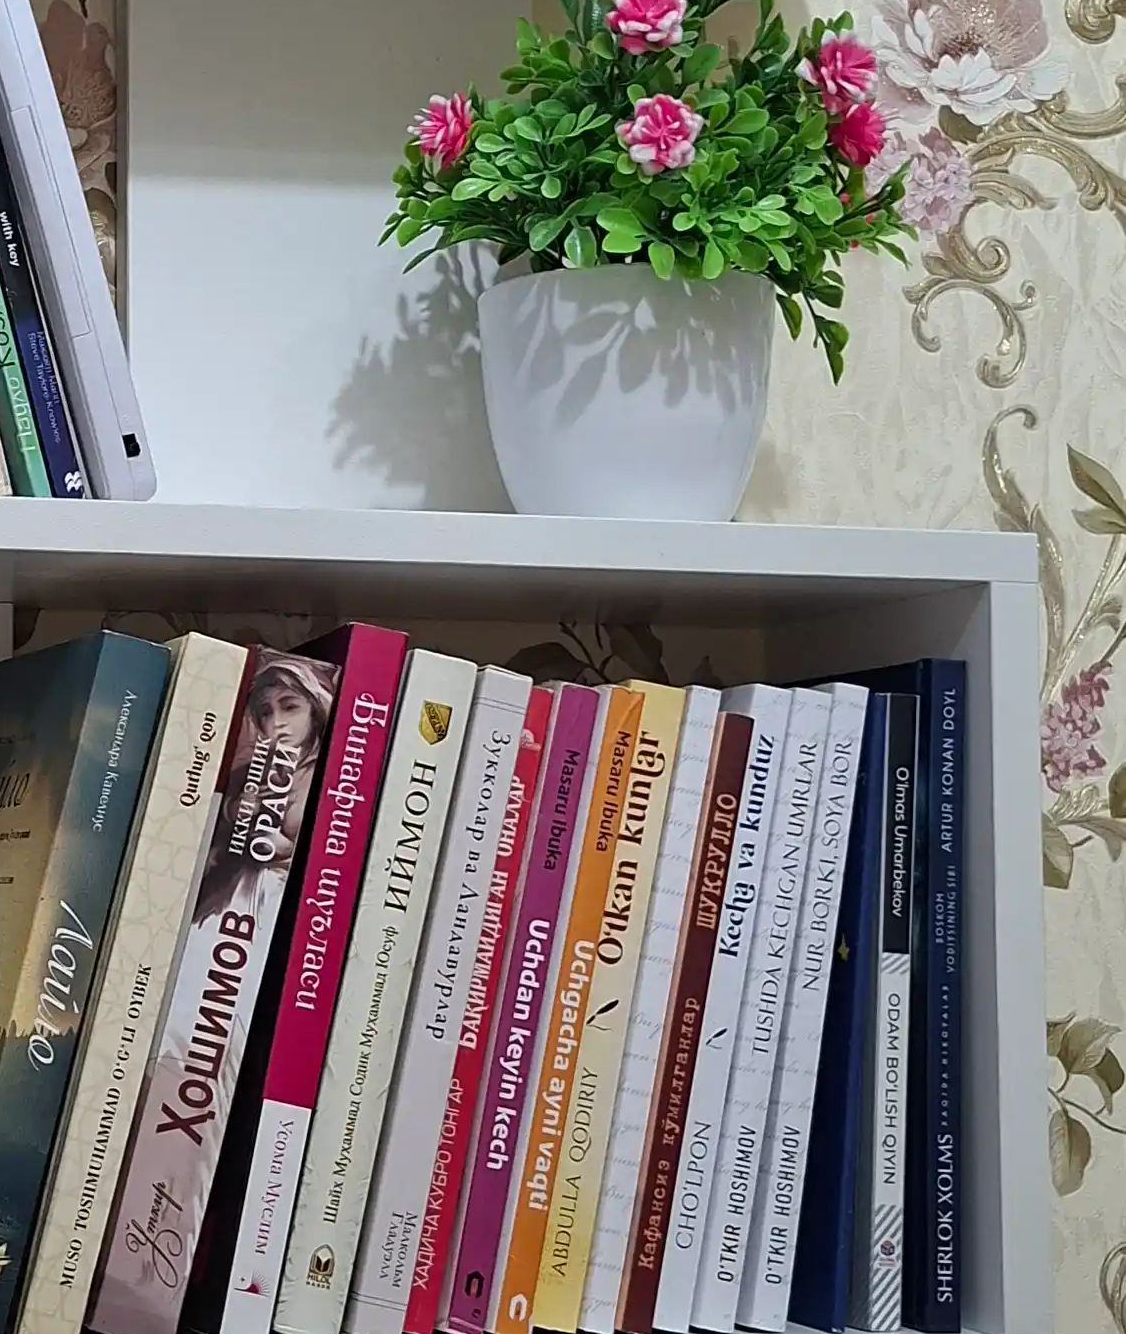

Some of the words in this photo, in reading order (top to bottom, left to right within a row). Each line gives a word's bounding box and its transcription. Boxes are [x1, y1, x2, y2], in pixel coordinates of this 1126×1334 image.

[0, 211, 13, 241] with
[6, 243, 20, 267] key
[9, 377, 37, 454] Пауло
[107, 689, 137, 767] Александра
[200, 712, 217, 743] qon
[942, 688, 957, 730] DOYL
[228, 799, 257, 856] ИККИ
[244, 735, 272, 796] ЭШИК
[325, 692, 389, 856] Бинафша
[466, 730, 511, 841] Зукколар
[554, 749, 581, 814] Masaru
[607, 730, 632, 798] Masaru
[618, 730, 666, 846] kunlar
[739, 733, 774, 832] kunduz
[830, 739, 852, 787] BOR
[894, 767, 910, 822] O'lmas
[941, 738, 955, 796] KONAN
[249, 740, 302, 862] ОРАСИ
[383, 759, 438, 914] ИЙМОН
[595, 801, 619, 852] Ibuka
[822, 794, 845, 849] SOYA
[940, 802, 954, 853] ARTUR
[465, 850, 480, 873] ва
[544, 819, 567, 870] Ibuka
[695, 793, 738, 930] ШУКРУЛЛО
[738, 842, 755, 869] va
[892, 826, 909, 917] Umarbekov
[718, 881, 756, 958] Kecha
[752, 968, 782, 1054] TUSHDA
[767, 843, 800, 959] KECHGAN
[787, 742, 818, 837] UMRLAR
[810, 855, 839, 933] BORKI,
[295, 867, 341, 1010] шуъласи
[426, 883, 481, 1040] Ландавурлар
[513, 919, 550, 1021] Uchdan
[802, 942, 825, 991] NUR
[28, 899, 93, 1072] Лайло
[554, 940, 595, 1071] Uchgacha
[887, 993, 901, 1051] ODAM
[323, 1181, 344, 1224] Шайх
[376, 926, 399, 970] Юсуф
[499, 1027, 531, 1100] keyin
[884, 1057, 899, 1128] BO'LISH
[60, 1238, 83, 1289] MUSO
[74, 1087, 121, 1232] TOSHMUHAMMAD
[127, 963, 152, 1020] OYBEK
[486, 1107, 517, 1170] kech
[542, 1079, 565, 1137] ayni
[638, 1160, 670, 1269] Кафансиз
[662, 998, 701, 1146] кўмилганлар
[269, 1120, 294, 1175] Усома
[413, 1215, 441, 1290] ХАДИЧА
[429, 1150, 451, 1210] КУБРО
[441, 1078, 462, 1145] ТОНГАР
[526, 1141, 555, 1211] vaqti
[551, 1175, 581, 1276] ABDULLA
[569, 1067, 598, 1163] QODIRIY
[675, 1121, 712, 1249] CHO'LPON
[728, 1125, 757, 1216] HOSHIMOV
[774, 1125, 801, 1217] HOSHIMOV
[882, 1134, 897, 1184] QIYIN
[937, 1133, 954, 1204] XOLMS
[254, 1181, 283, 1255] Муслим
[379, 1211, 404, 1279] Гладуэлл
[392, 1211, 419, 1287] Малкольм
[717, 1224, 741, 1283] O'TKIR
[765, 1226, 788, 1284] O'TKIR
[937, 1210, 954, 1303] SHERLOK
